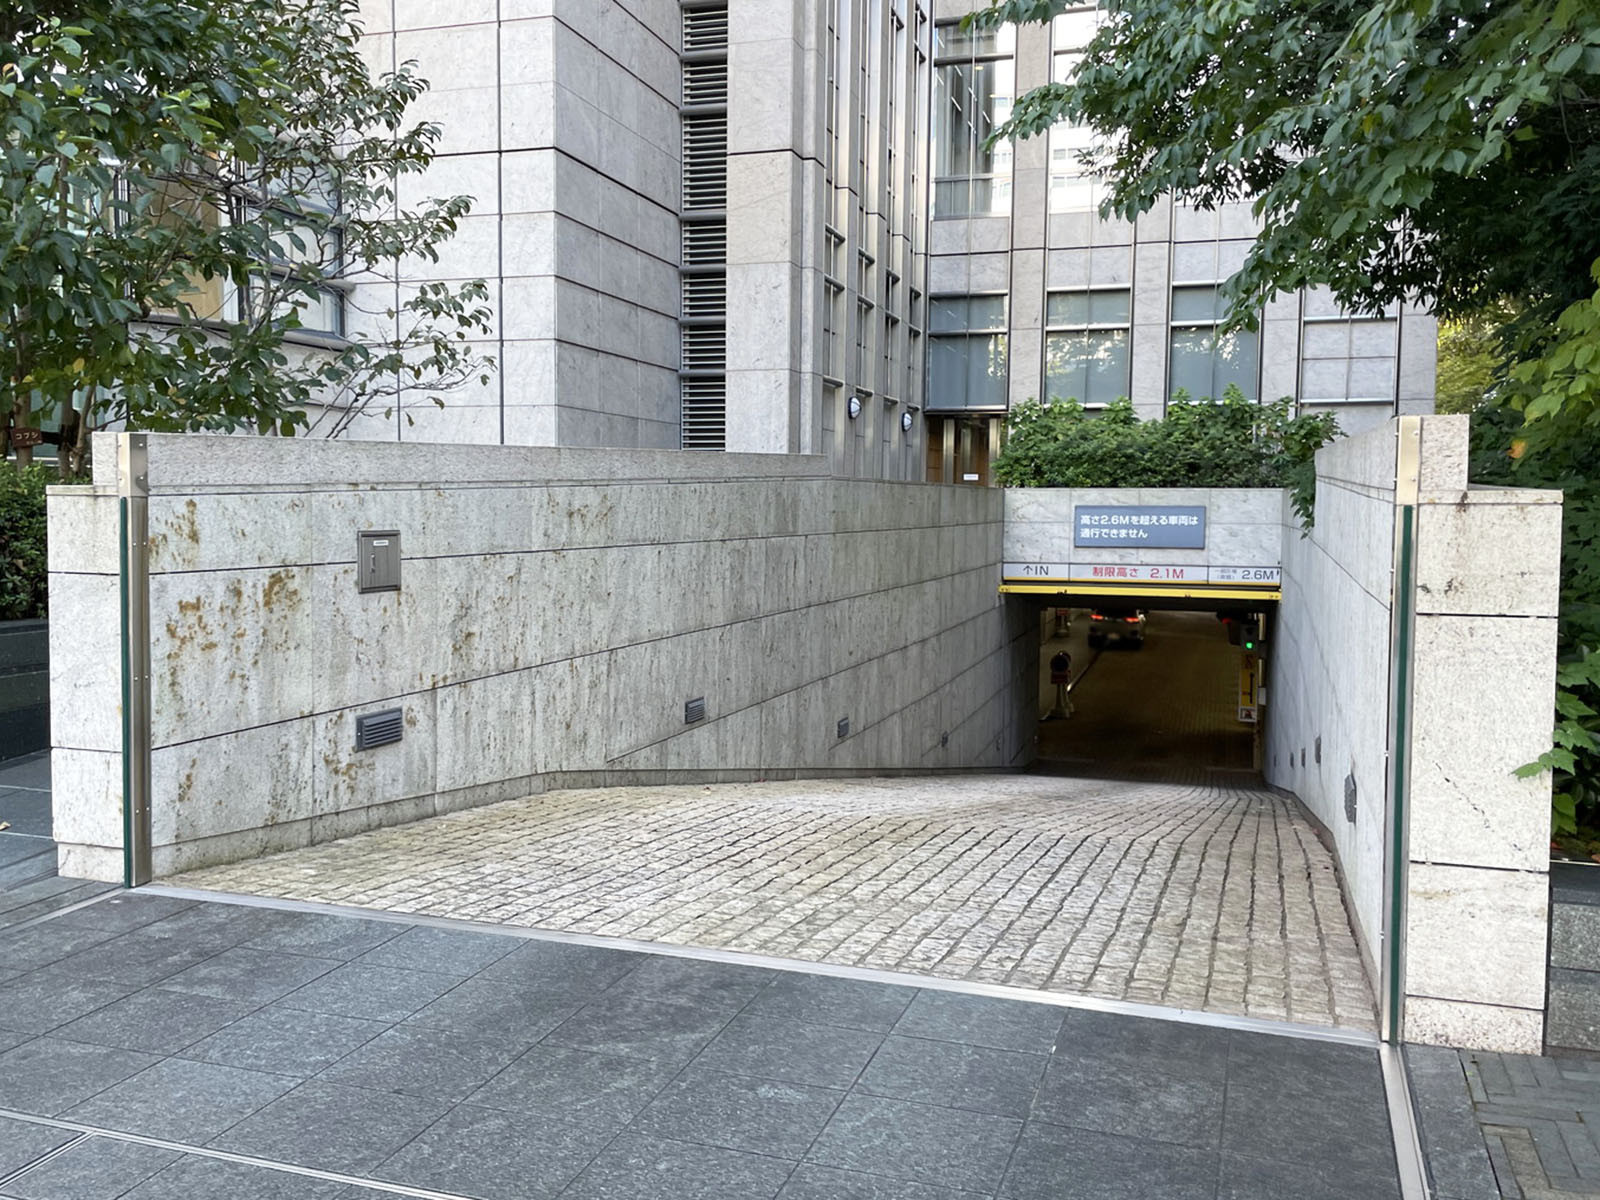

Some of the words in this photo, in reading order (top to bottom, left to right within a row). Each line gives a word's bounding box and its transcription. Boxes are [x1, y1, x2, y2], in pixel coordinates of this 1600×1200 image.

[1080, 515, 1199, 526] 高さ2.6Mを超える車両は
[1080, 528, 1148, 538] 通行できません
[1034, 566, 1050, 576] IN
[1092, 567, 1140, 578] 制限高さ
[1150, 568, 1185, 579] 2.1M
[1241, 569, 1274, 580] 2.6M
